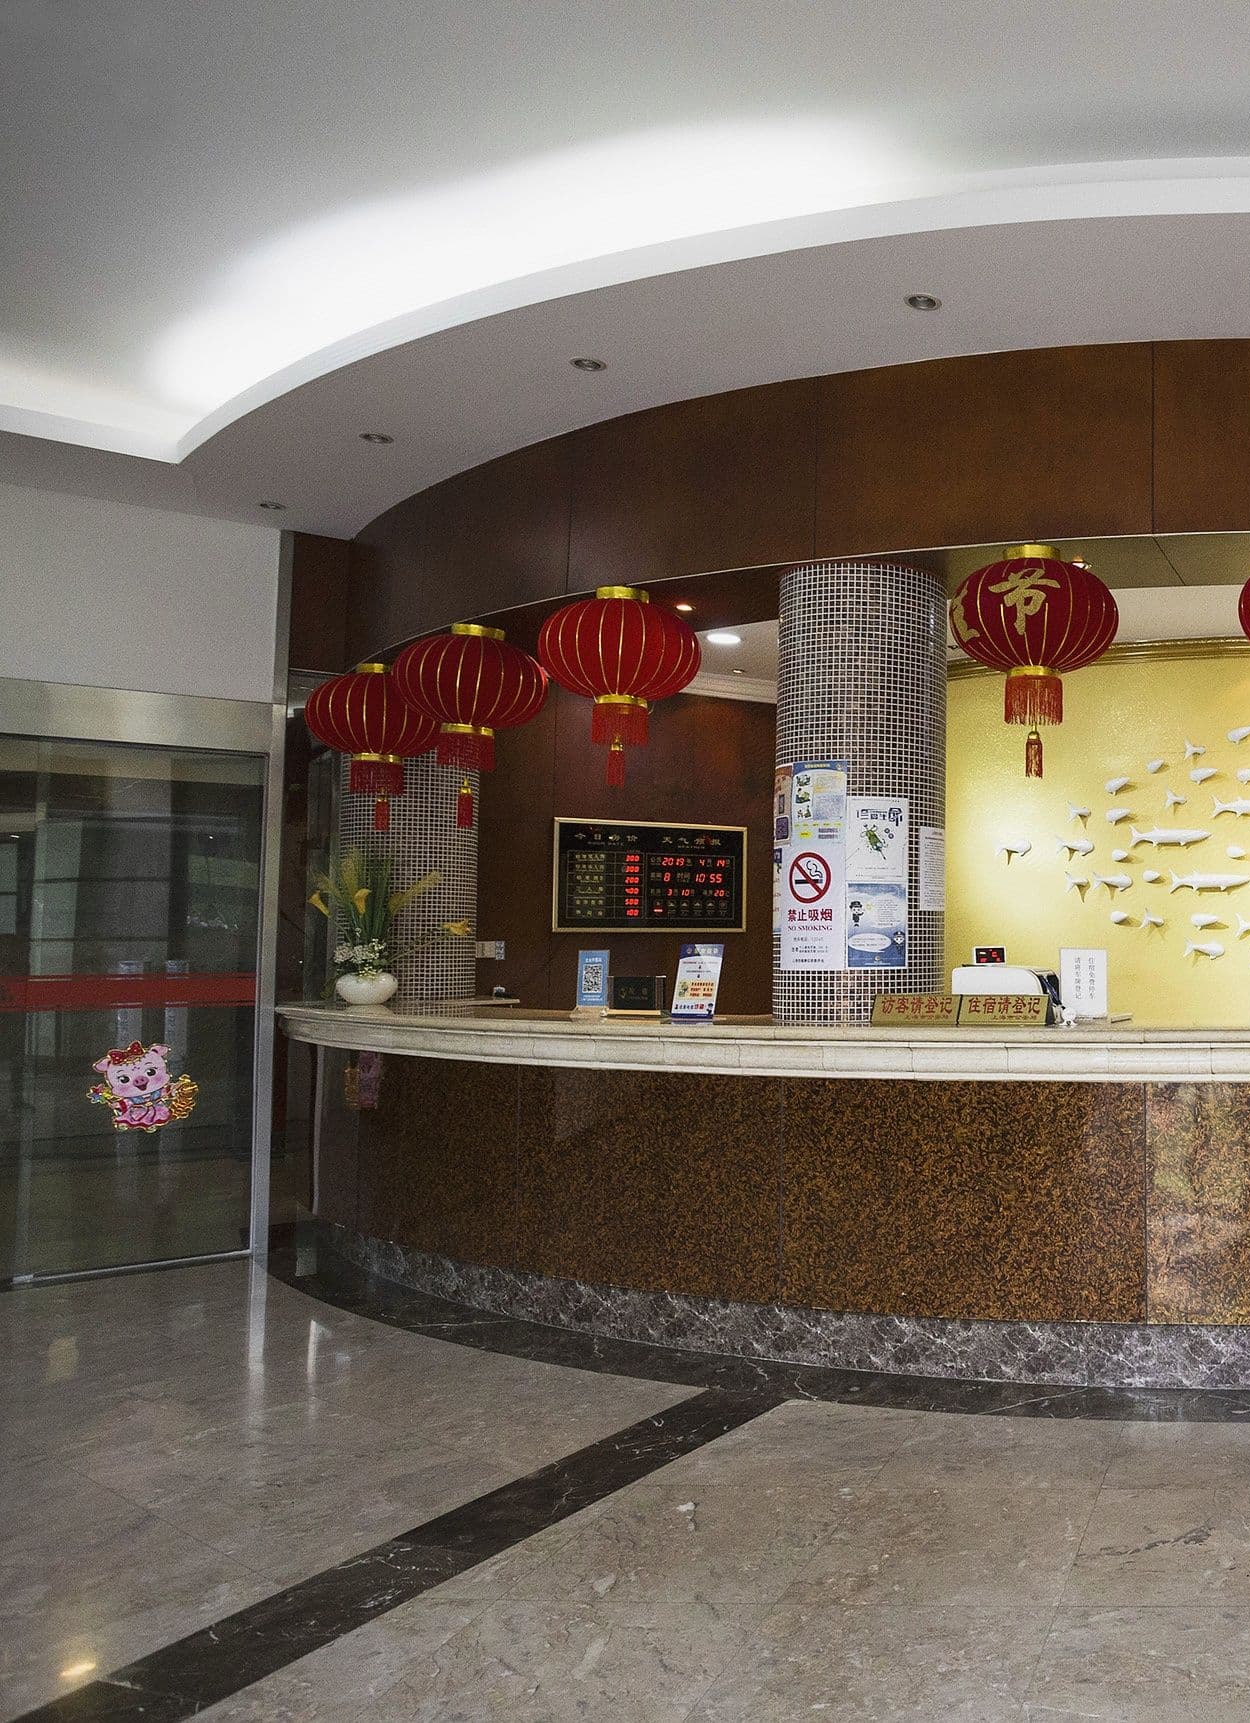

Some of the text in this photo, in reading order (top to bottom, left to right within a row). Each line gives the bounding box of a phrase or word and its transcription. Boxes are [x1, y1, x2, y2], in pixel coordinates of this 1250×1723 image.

[661, 857, 685, 867] 2019
[698, 859, 706, 867] 4
[716, 859, 726, 867] 14
[663, 872, 671, 882] 8
[695, 873, 706, 883] 10
[709, 873, 723, 883] 55
[714, 889, 725, 897] 20
[787, 908, 833, 922] 禁止吸烟
[881, 997, 953, 1014] 访客请登记
[968, 997, 1041, 1014] 住宿请登记
